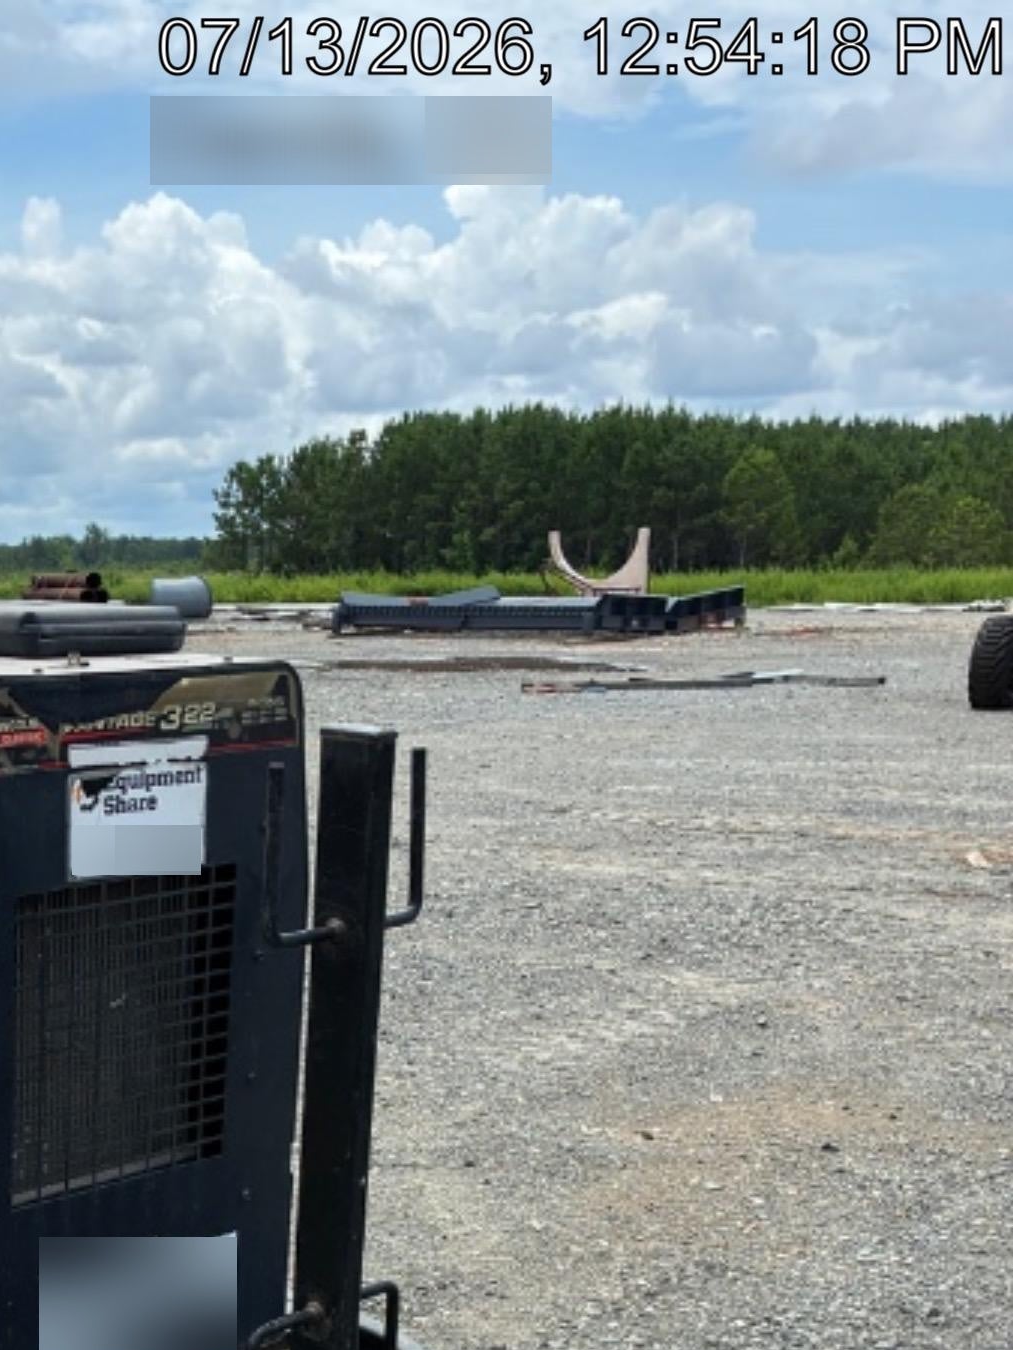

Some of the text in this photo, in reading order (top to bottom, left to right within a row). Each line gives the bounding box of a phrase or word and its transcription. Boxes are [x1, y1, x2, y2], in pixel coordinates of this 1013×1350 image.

[59, 711, 157, 736] TAGE
[160, 702, 216, 730] 322
[104, 795, 157, 815] Share
